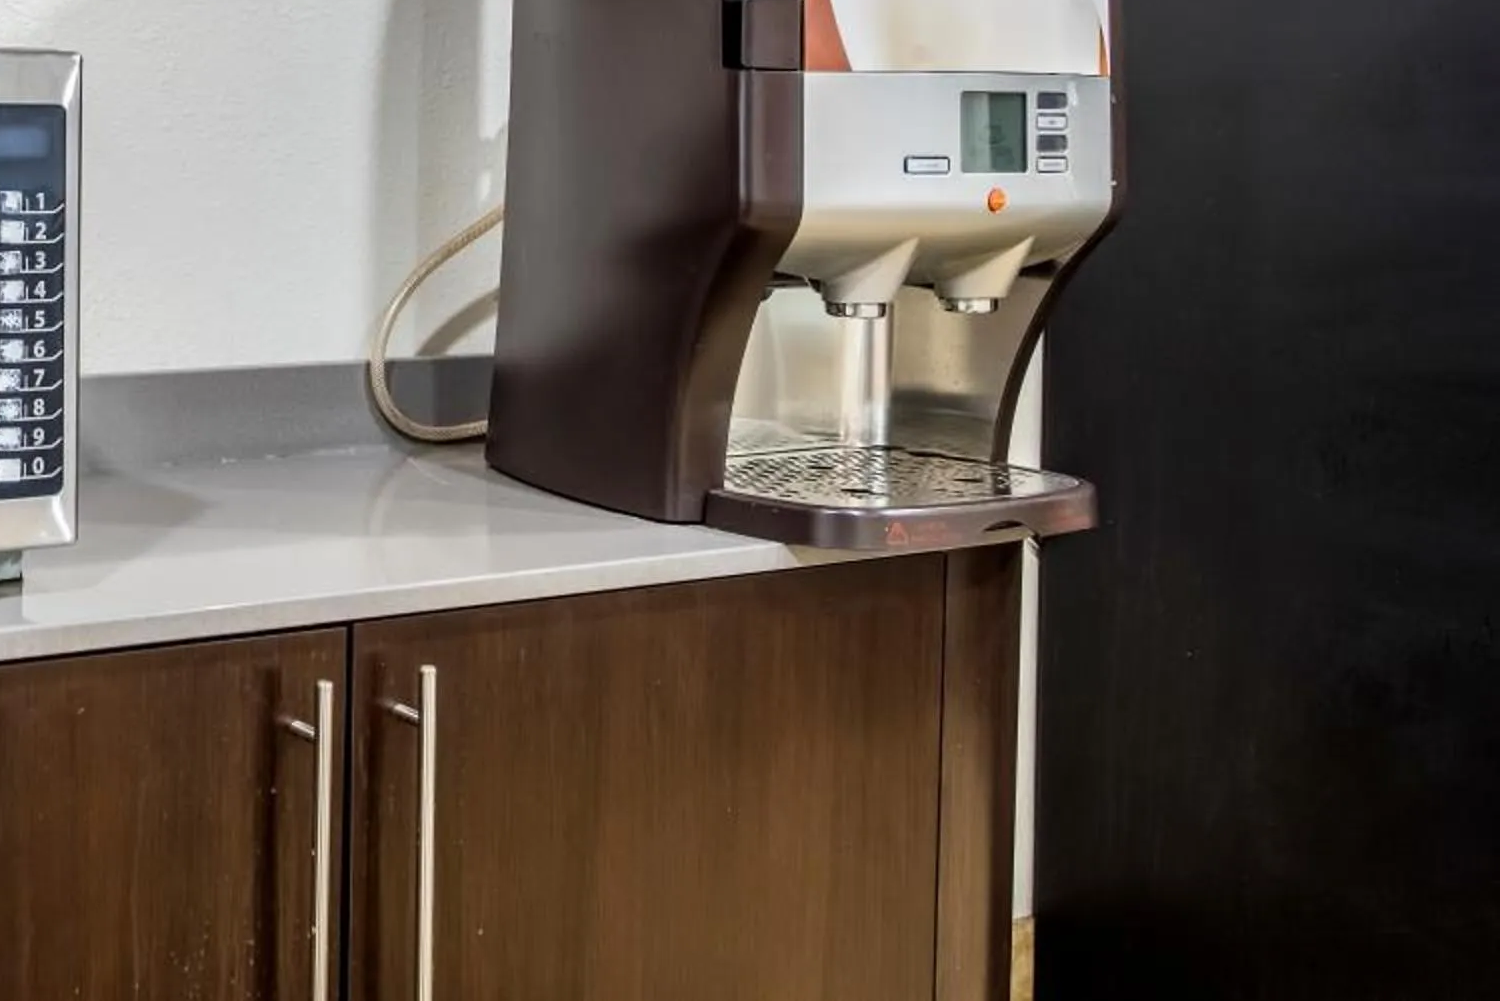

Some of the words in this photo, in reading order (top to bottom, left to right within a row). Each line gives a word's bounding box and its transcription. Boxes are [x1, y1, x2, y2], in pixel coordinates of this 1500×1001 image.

[35, 192, 46, 210] 1
[35, 222, 47, 240] 2
[34, 251, 46, 270] 3
[33, 280, 46, 298] 4
[33, 310, 46, 328] 5
[33, 340, 45, 357] 6
[32, 369, 45, 387] 7
[32, 398, 45, 416] 8
[32, 427, 45, 446] 9
[32, 456, 45, 475] 0
